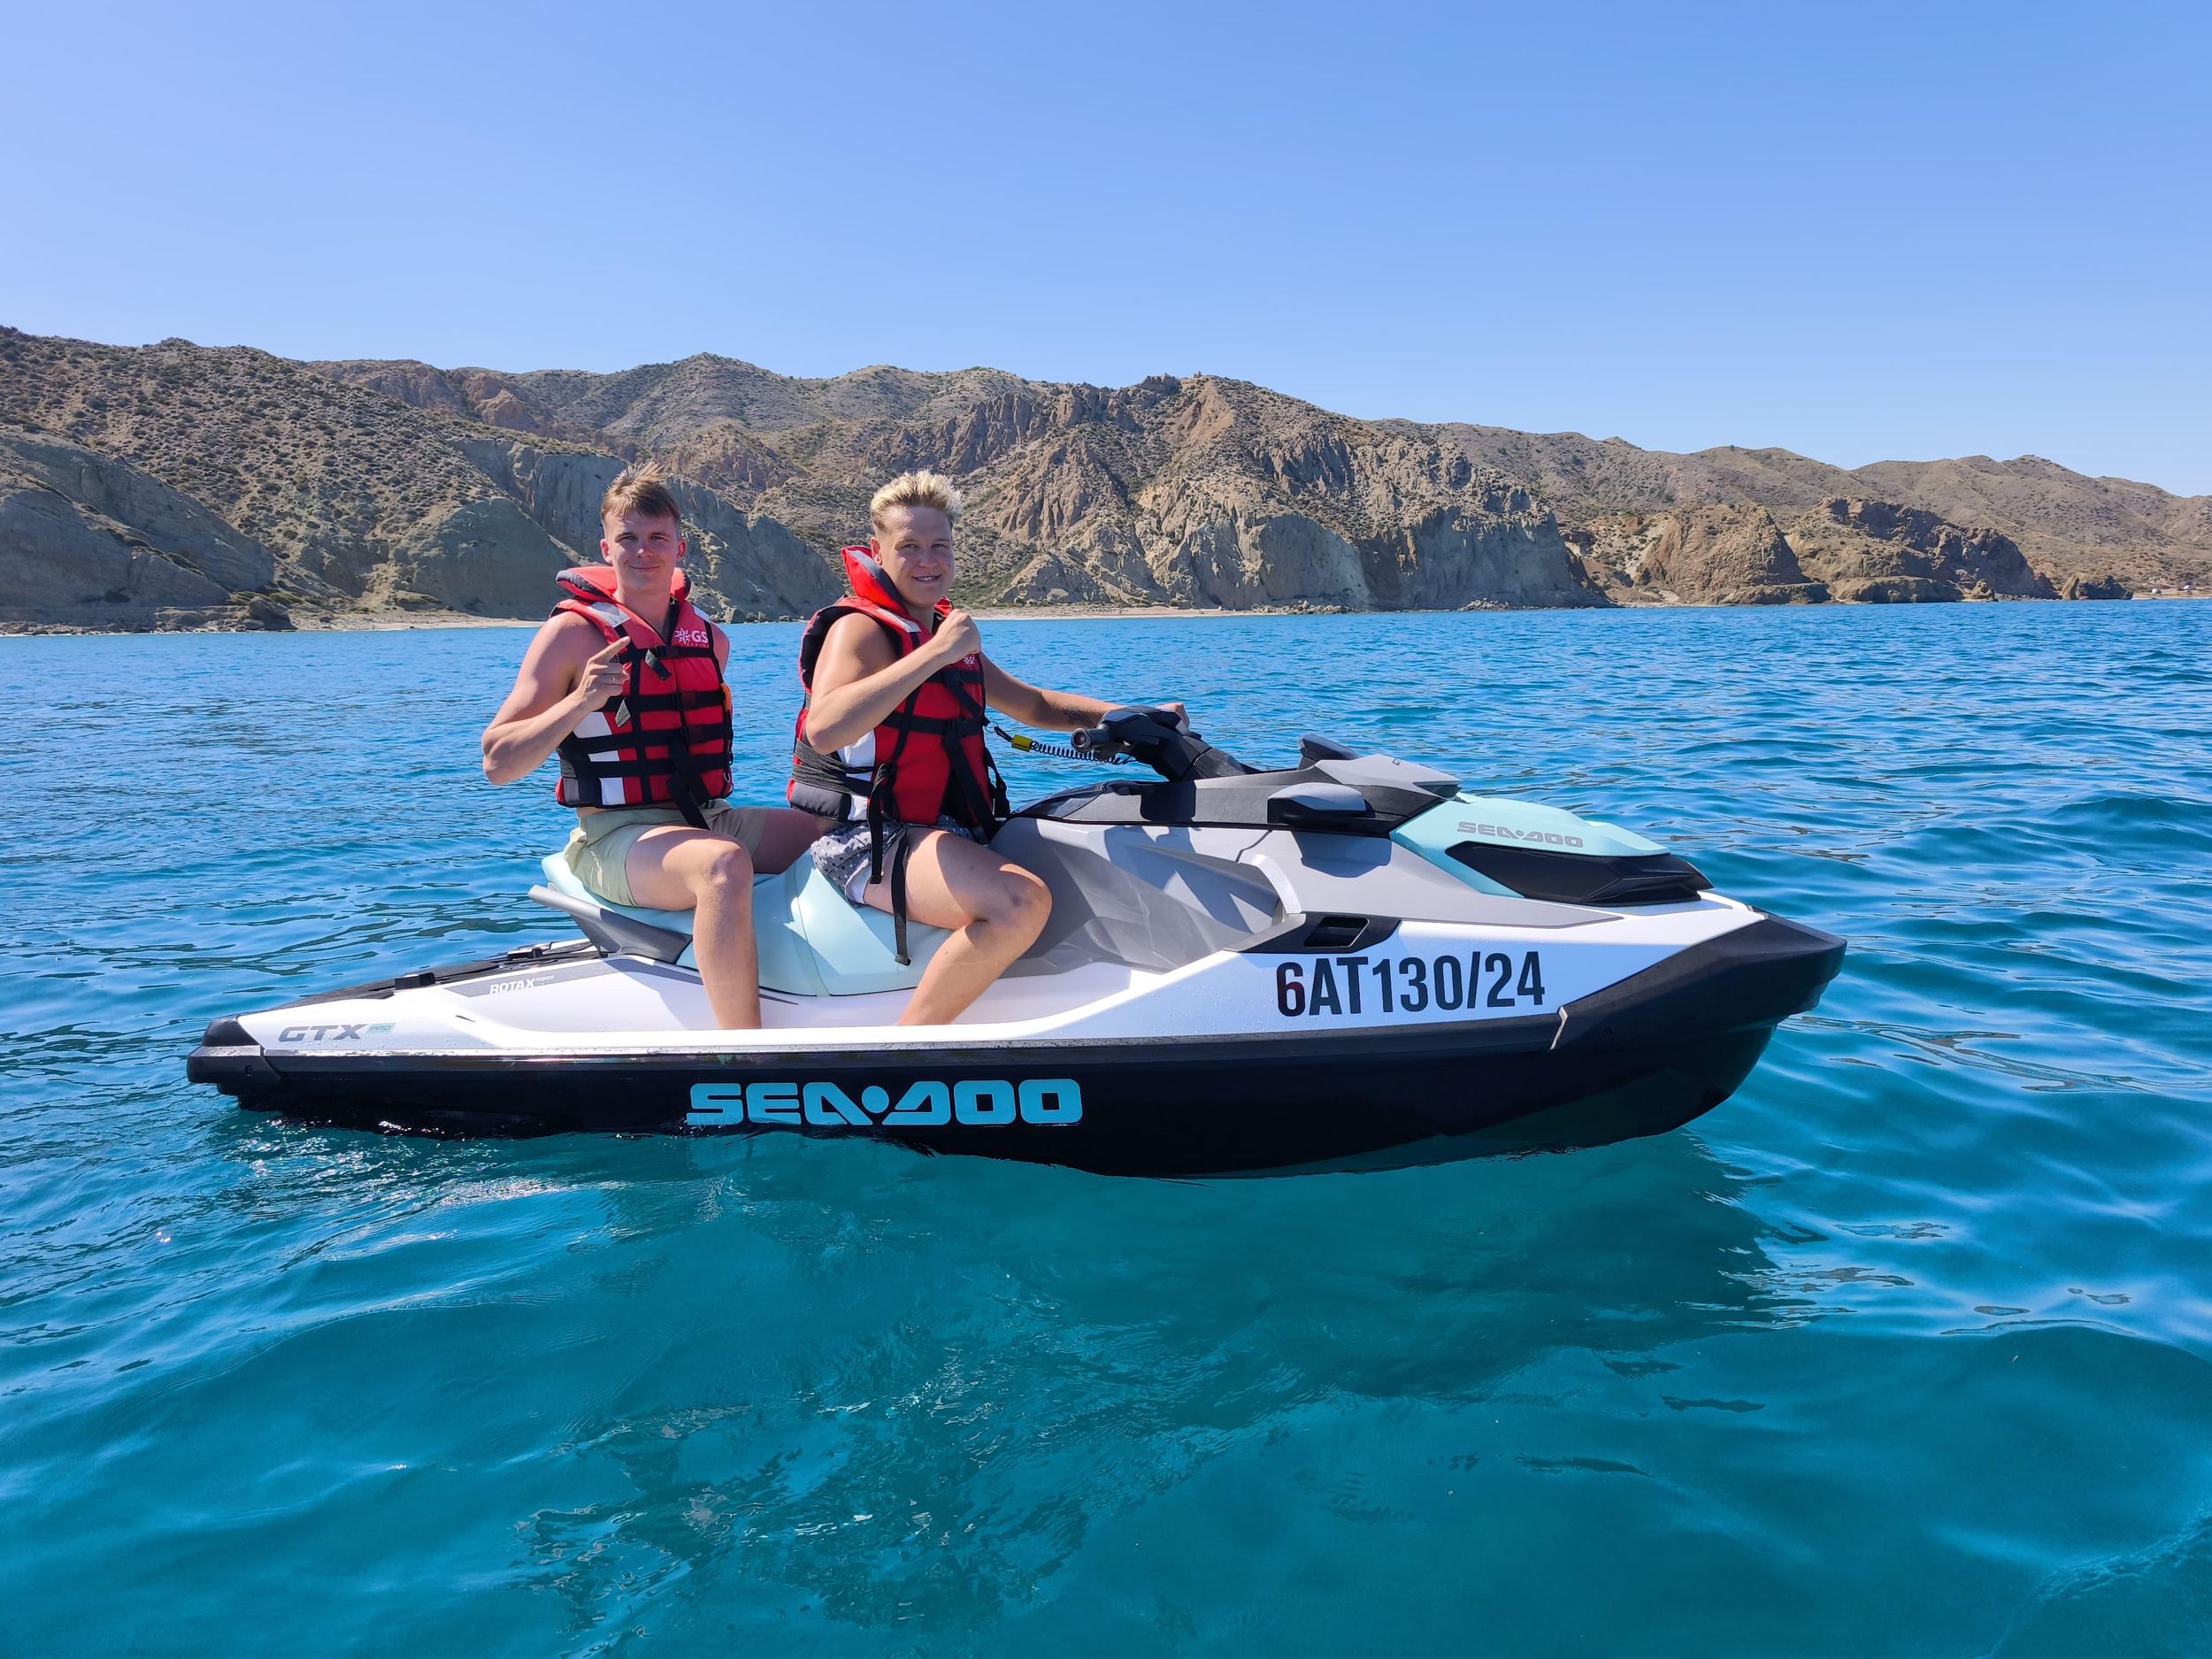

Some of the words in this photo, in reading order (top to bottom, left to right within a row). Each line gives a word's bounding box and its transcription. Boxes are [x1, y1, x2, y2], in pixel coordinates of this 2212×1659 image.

[489, 978, 535, 995] ROTAX
[1276, 950, 1546, 1018] 6AT130/24
[278, 1023, 369, 1042] GTX
